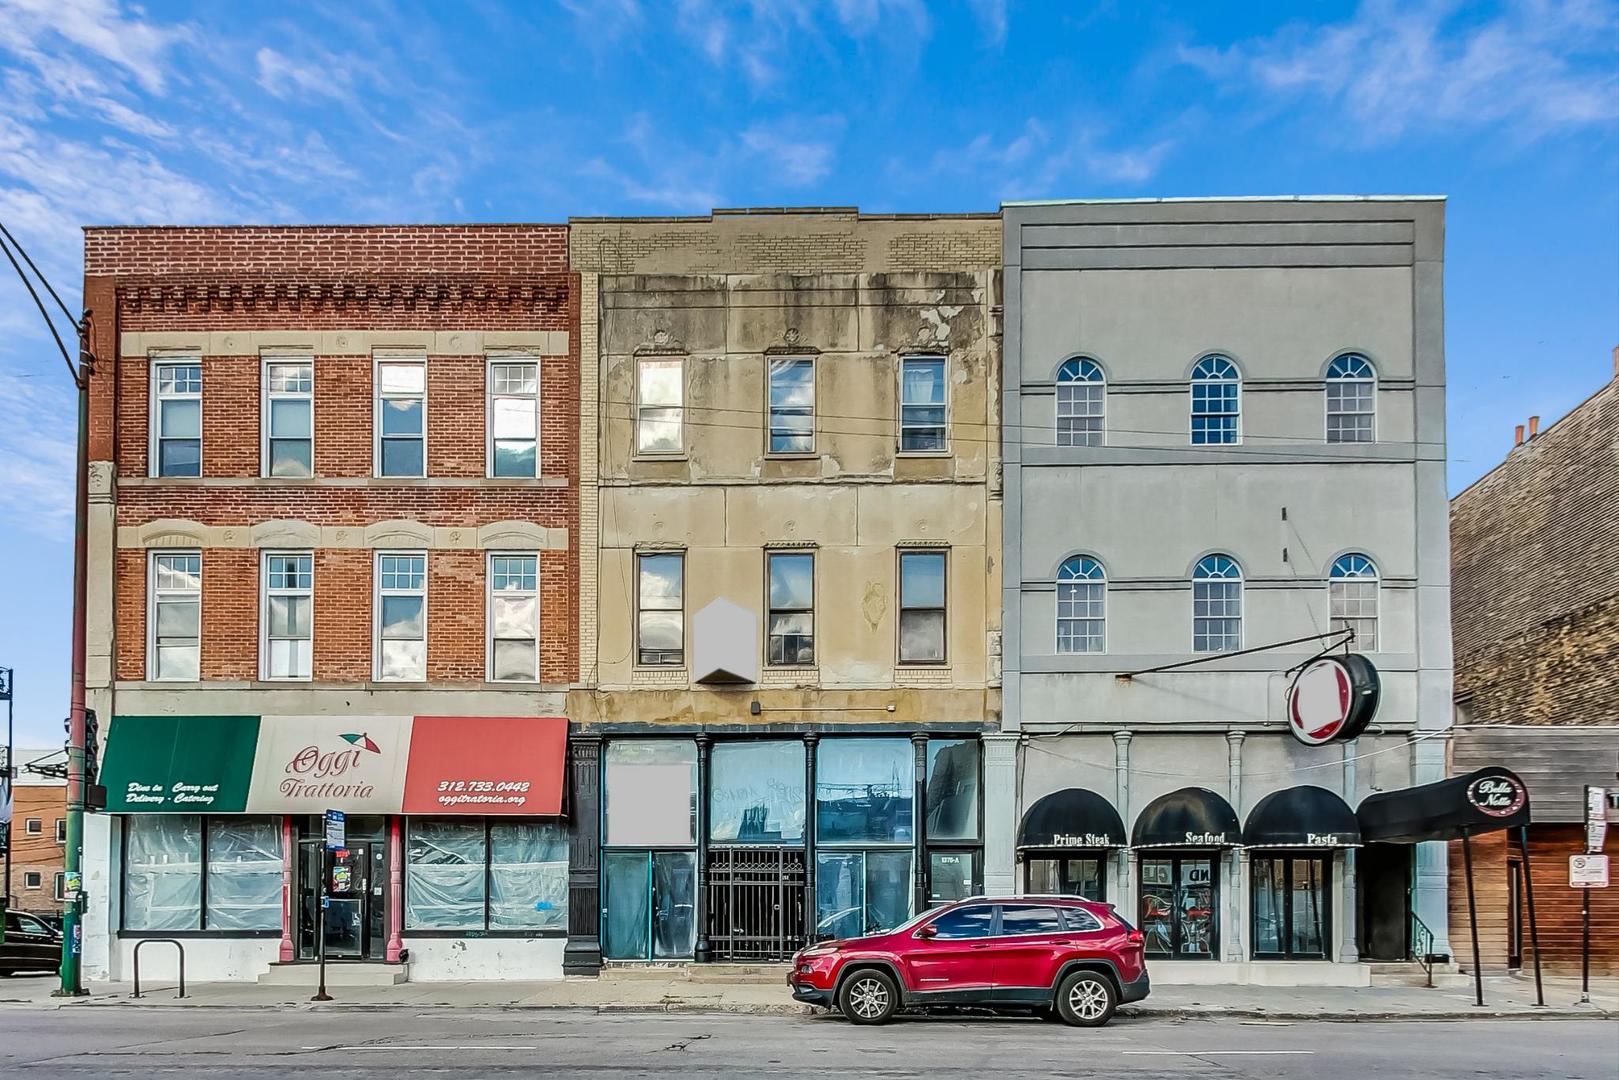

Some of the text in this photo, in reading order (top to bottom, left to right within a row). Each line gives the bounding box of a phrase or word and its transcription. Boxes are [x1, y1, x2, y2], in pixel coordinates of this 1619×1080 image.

[285, 745, 361, 778] Oggi
[128, 782, 219, 793] Dine in Carry out
[279, 778, 374, 798] Trattoria
[437, 781, 530, 792] 312.733.0442
[1479, 780, 1512, 793] Bella
[126, 793, 165, 804] Delivery
[174, 793, 214, 804] Catering
[1053, 833, 1110, 846] Prime Steak
[1185, 832, 1225, 844] Seafood
[1307, 833, 1338, 845] Pasta
